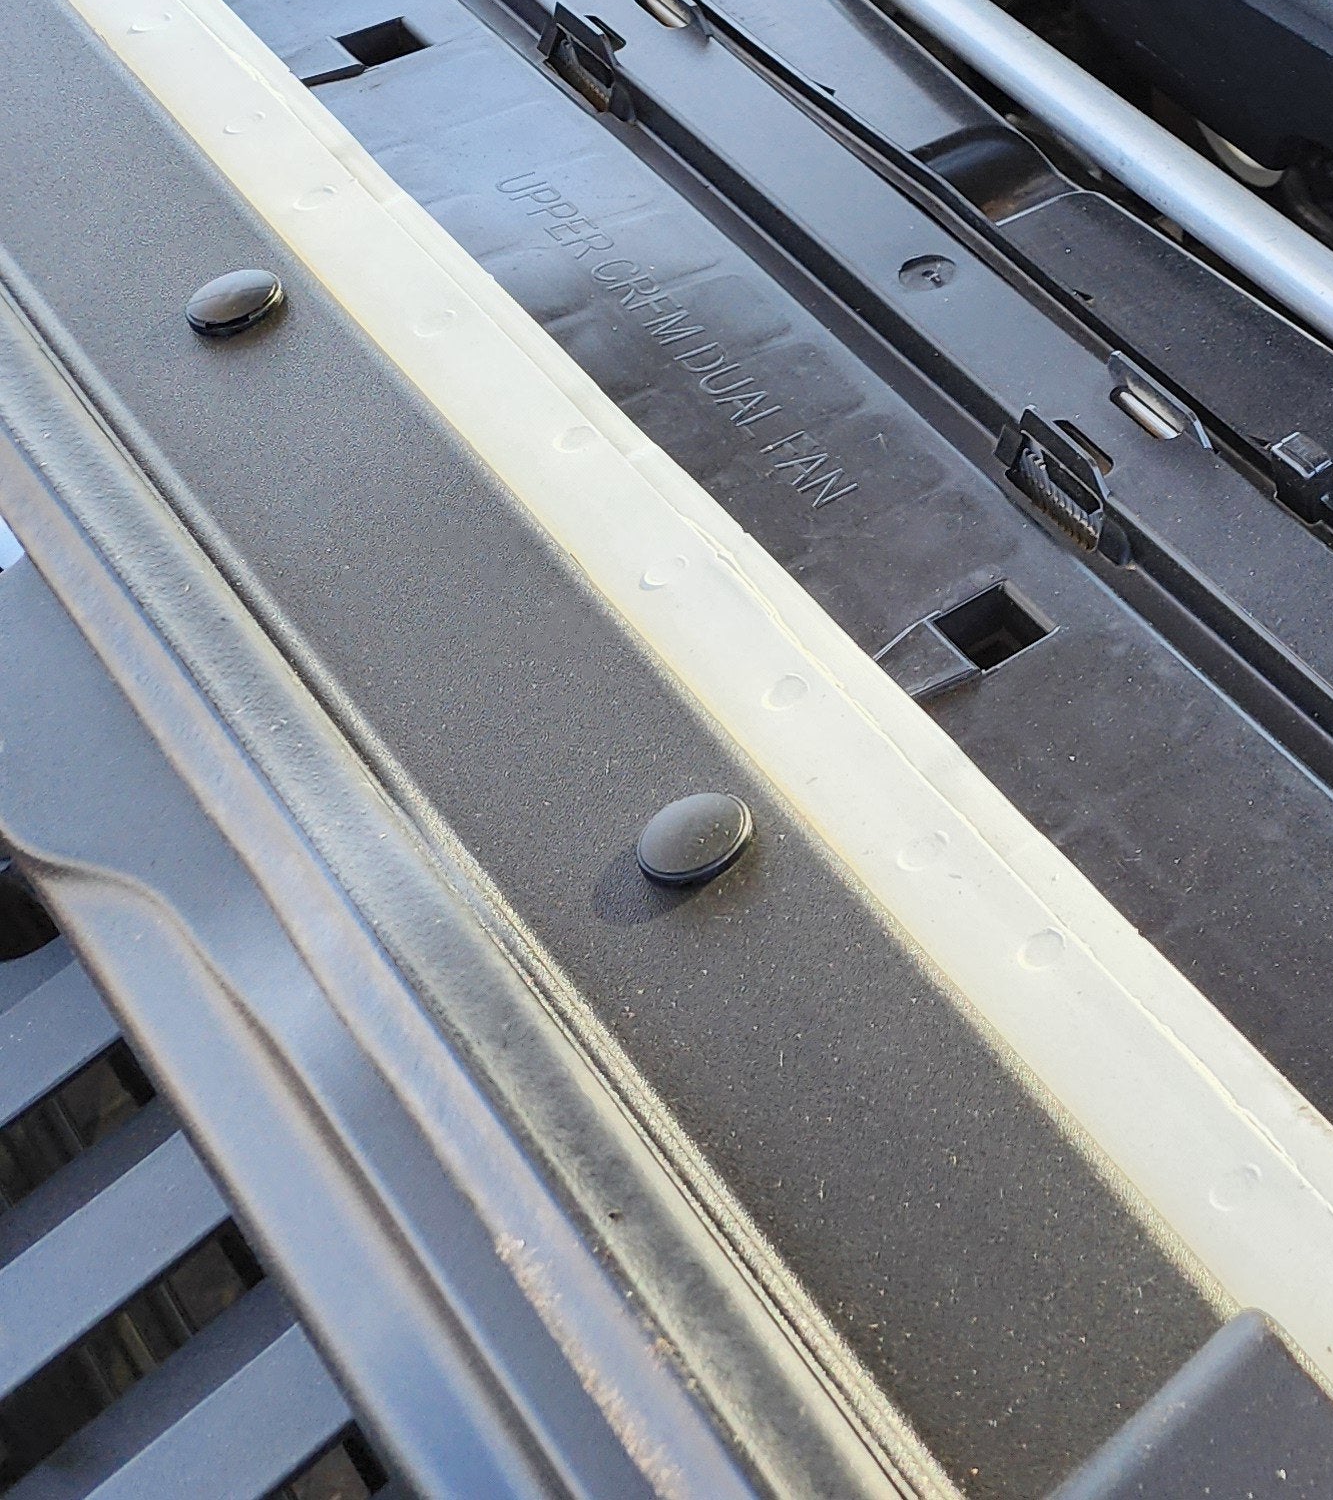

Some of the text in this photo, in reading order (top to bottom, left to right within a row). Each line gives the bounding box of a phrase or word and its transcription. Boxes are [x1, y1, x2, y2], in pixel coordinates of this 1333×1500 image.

[495, 171, 859, 509] UPPER CRFM DUAL FAN
